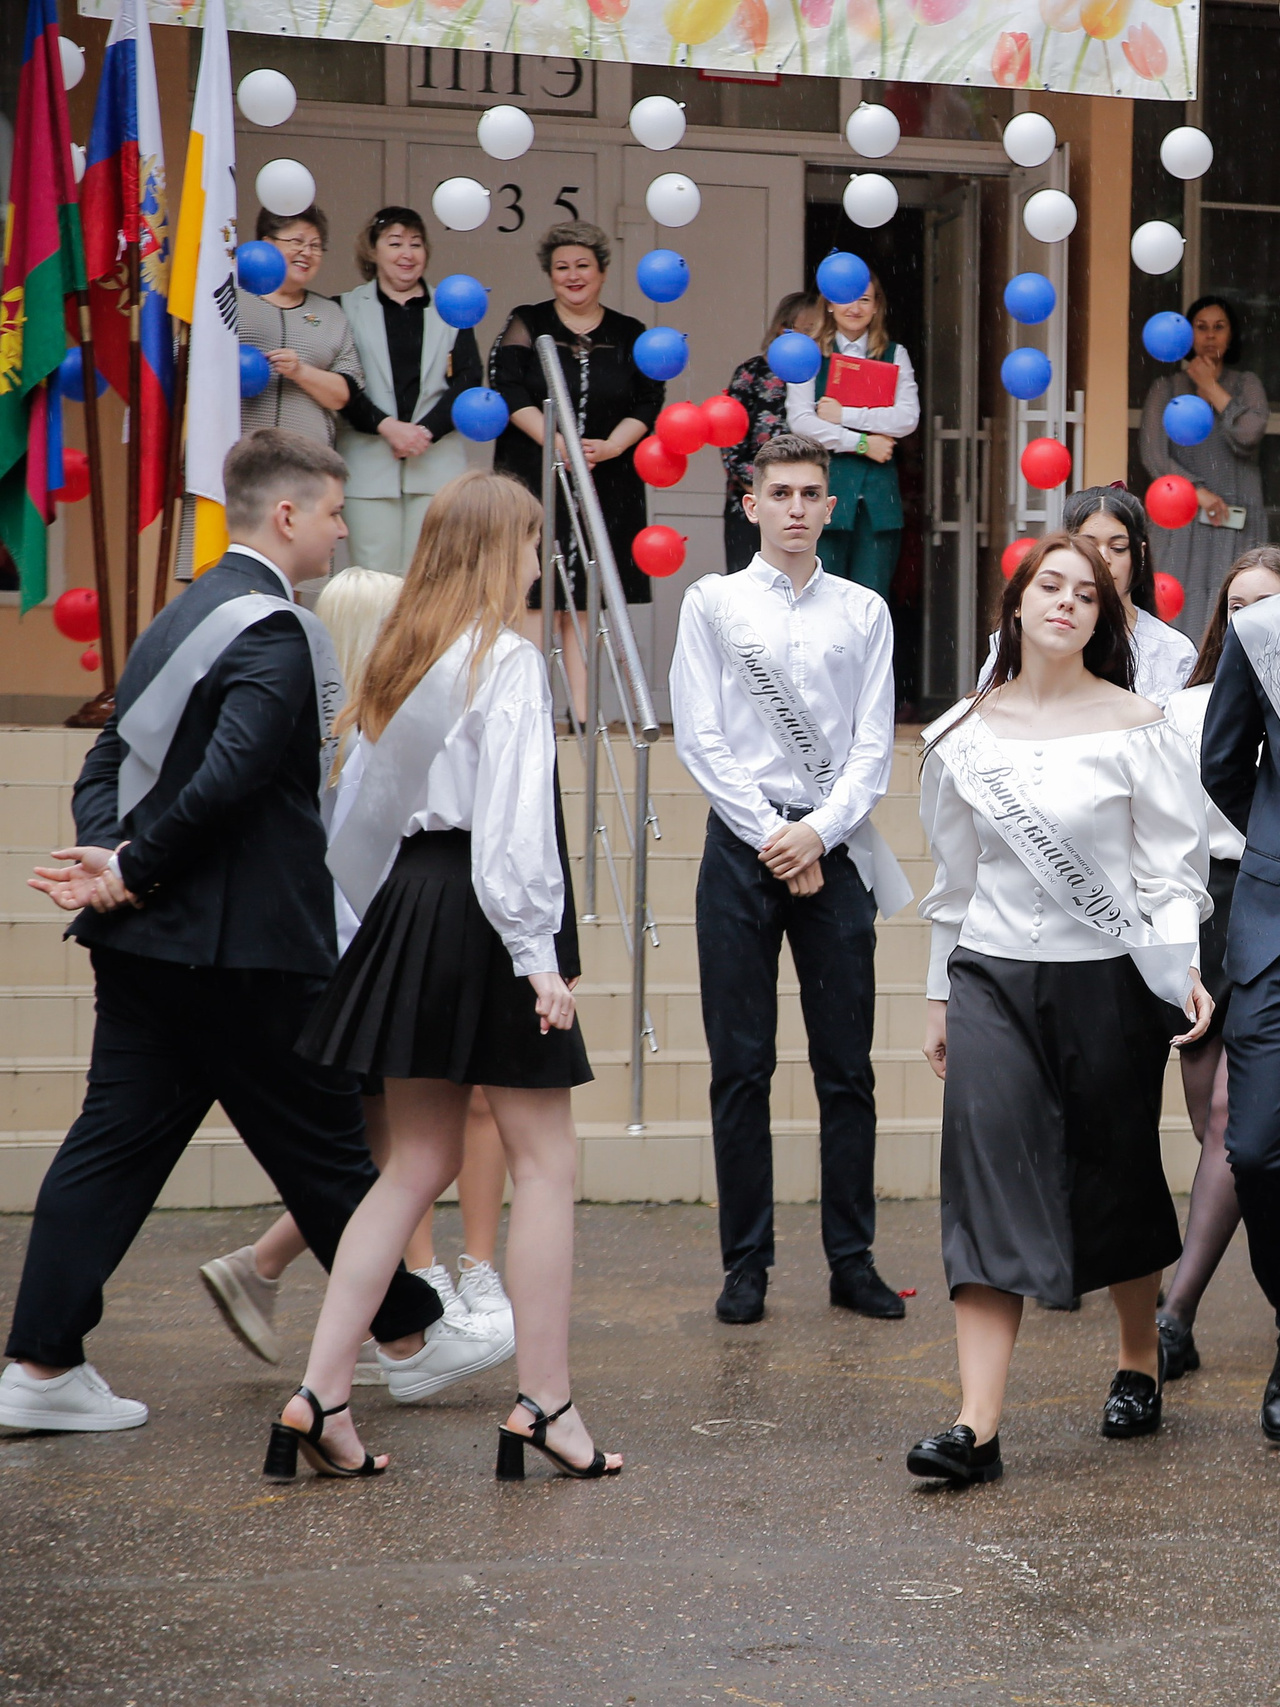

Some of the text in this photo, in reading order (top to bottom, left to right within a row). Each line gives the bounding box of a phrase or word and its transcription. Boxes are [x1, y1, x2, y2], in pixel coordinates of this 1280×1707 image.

[727, 623, 836, 796] Выпускник 20
[973, 750, 1133, 938] Выпускница 2023
[1057, 835, 1095, 876] Анастасия
